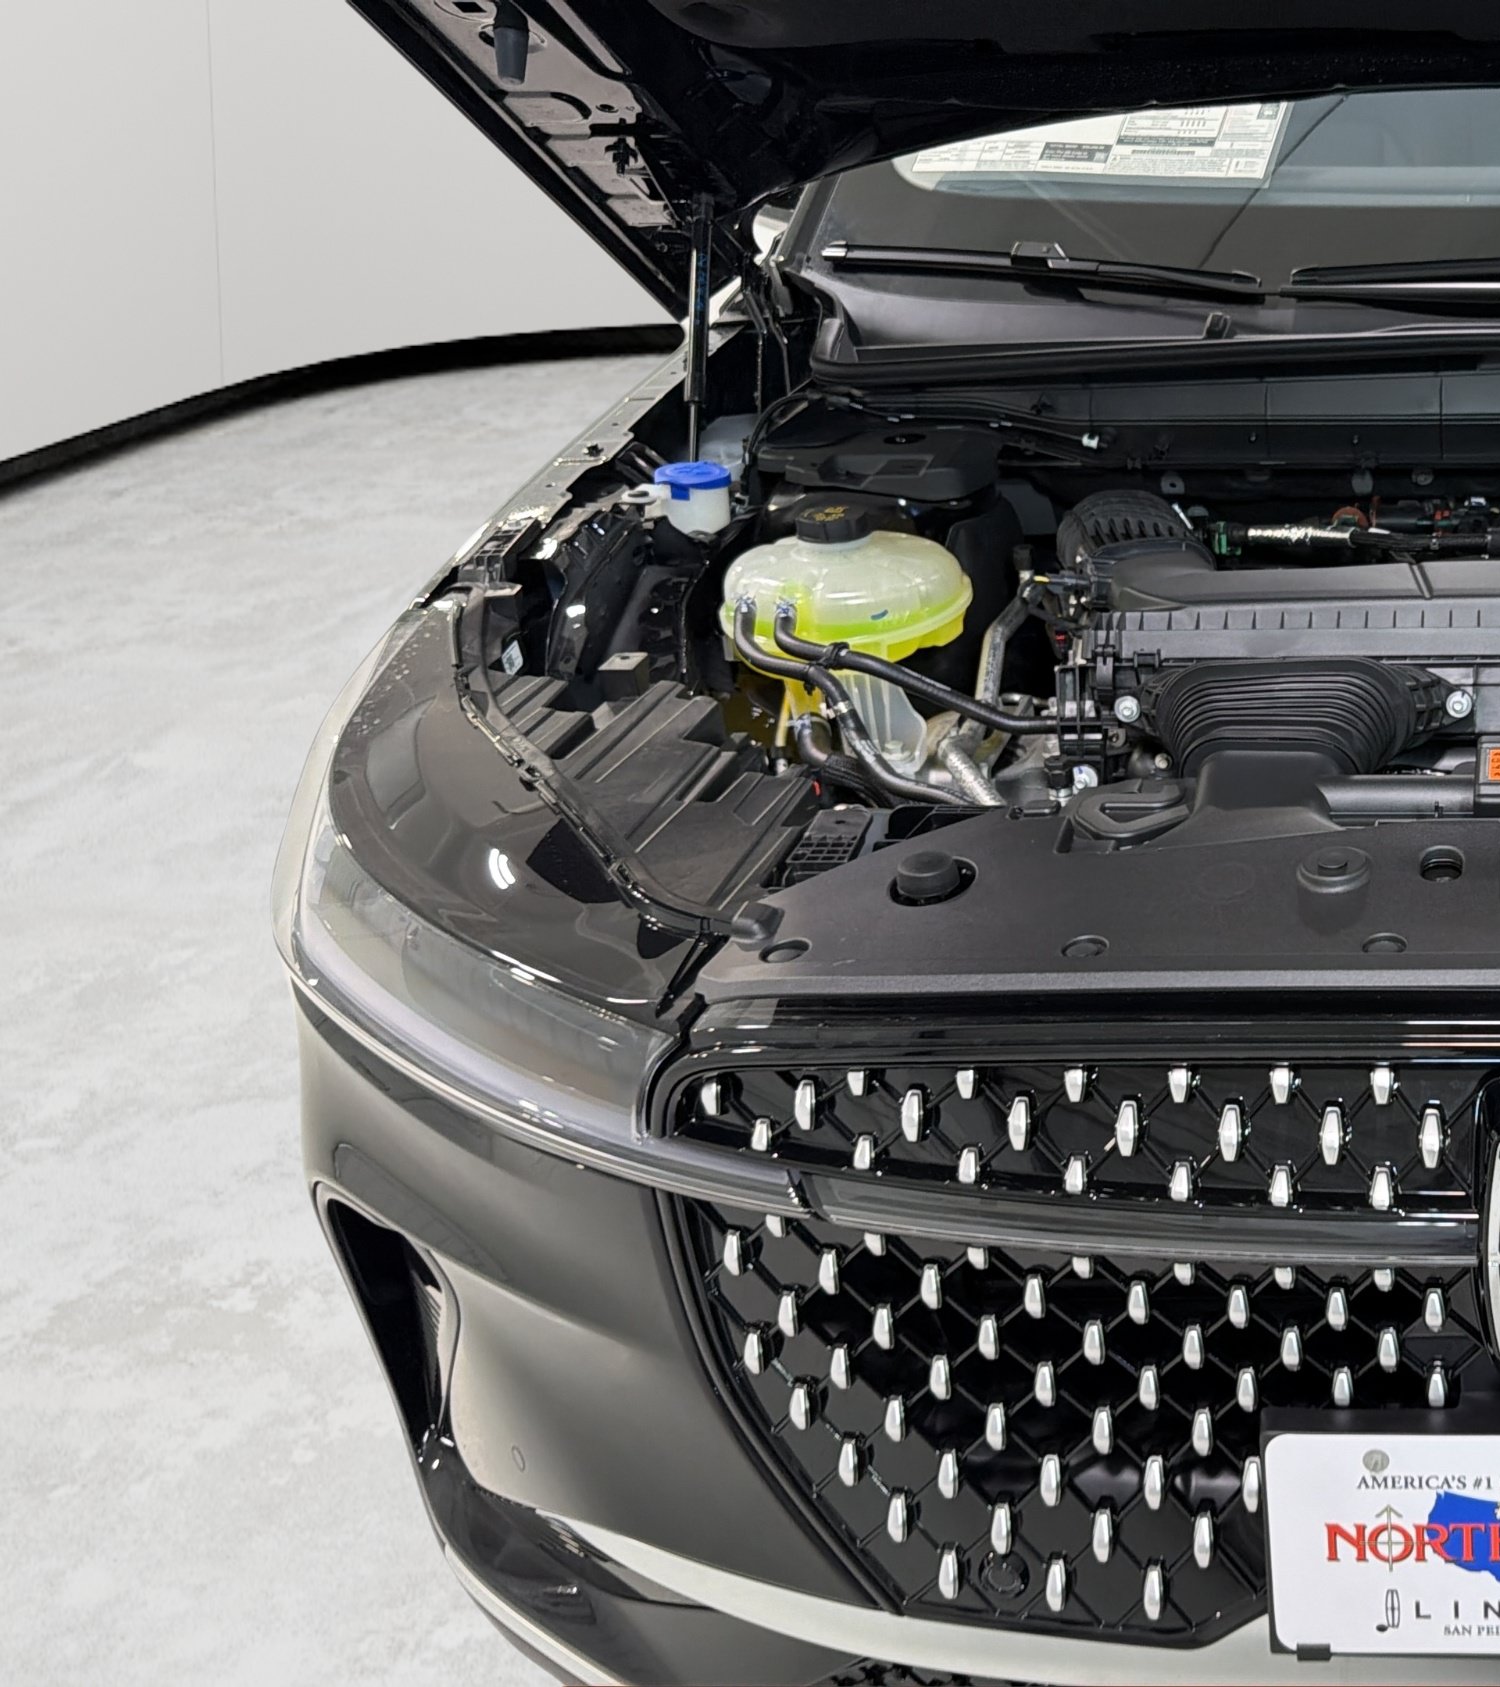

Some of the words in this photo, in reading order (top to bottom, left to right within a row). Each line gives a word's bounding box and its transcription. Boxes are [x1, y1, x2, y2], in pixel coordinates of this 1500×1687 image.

[1357, 1475, 1467, 1490] AMERICA'S
[1473, 1475, 1493, 1490] #1
[1443, 1625, 1472, 1637] SAN
